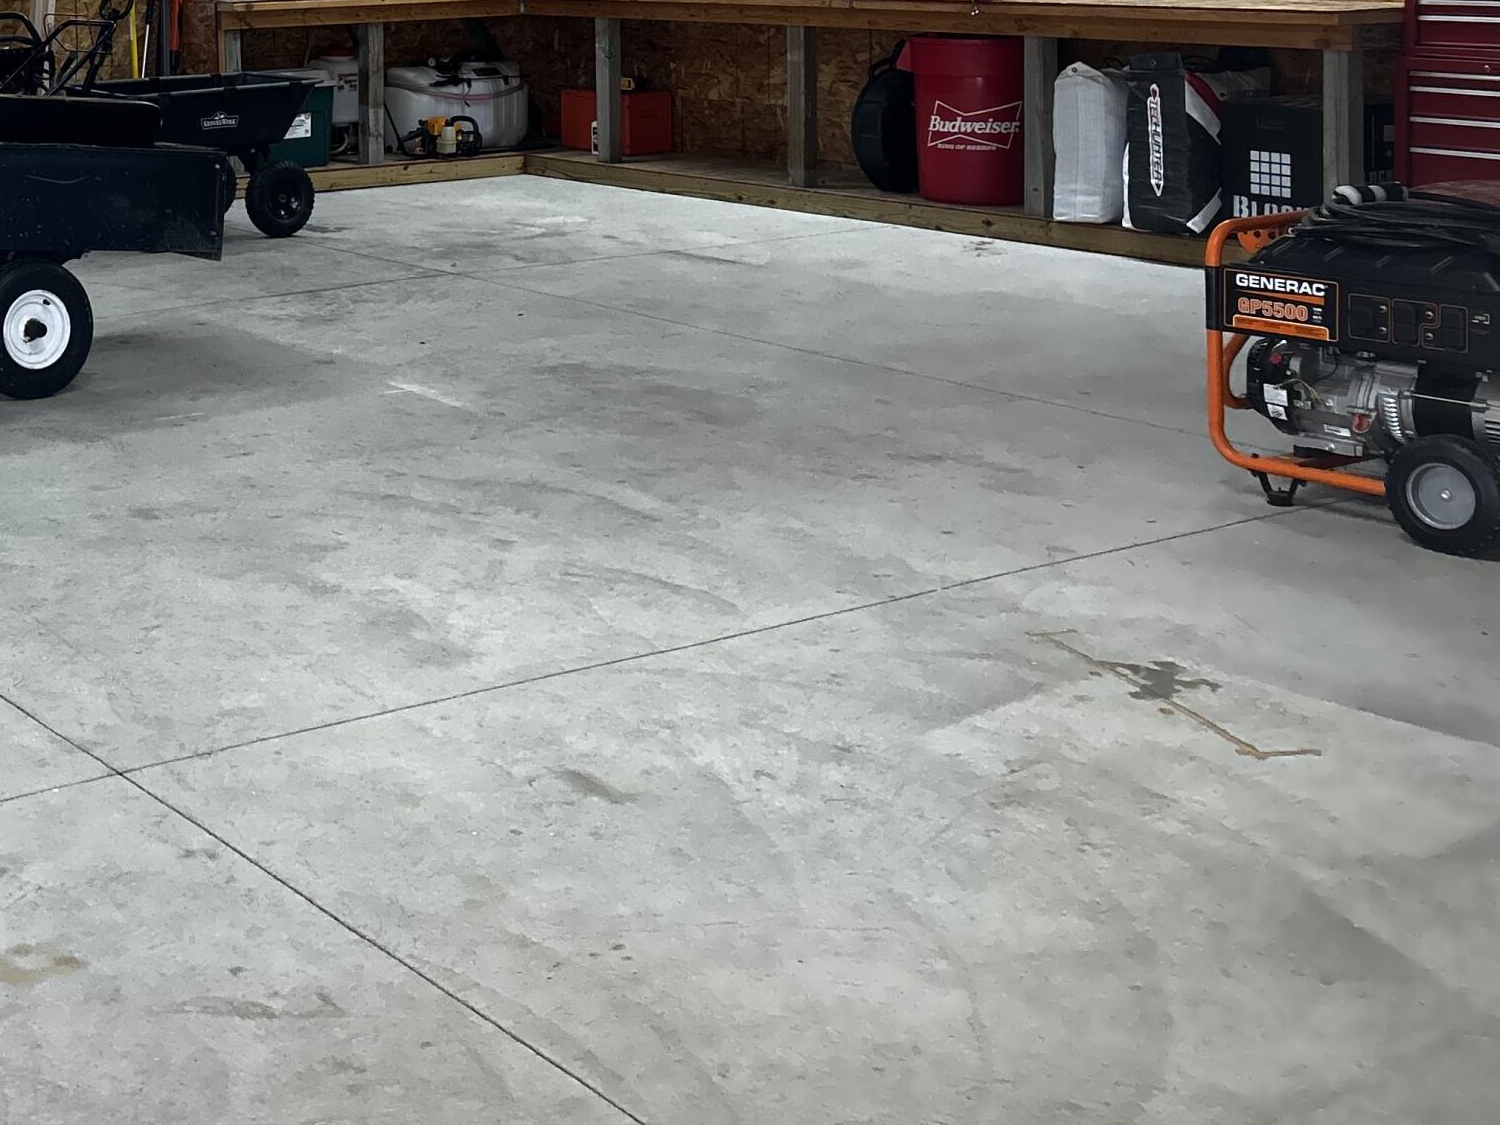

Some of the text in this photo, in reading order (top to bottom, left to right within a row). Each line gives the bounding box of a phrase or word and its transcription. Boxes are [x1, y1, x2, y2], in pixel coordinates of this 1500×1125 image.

[1233, 194, 1309, 219] BLO
[1235, 273, 1326, 296] GENERAC
[1238, 297, 1308, 322] GP5500
